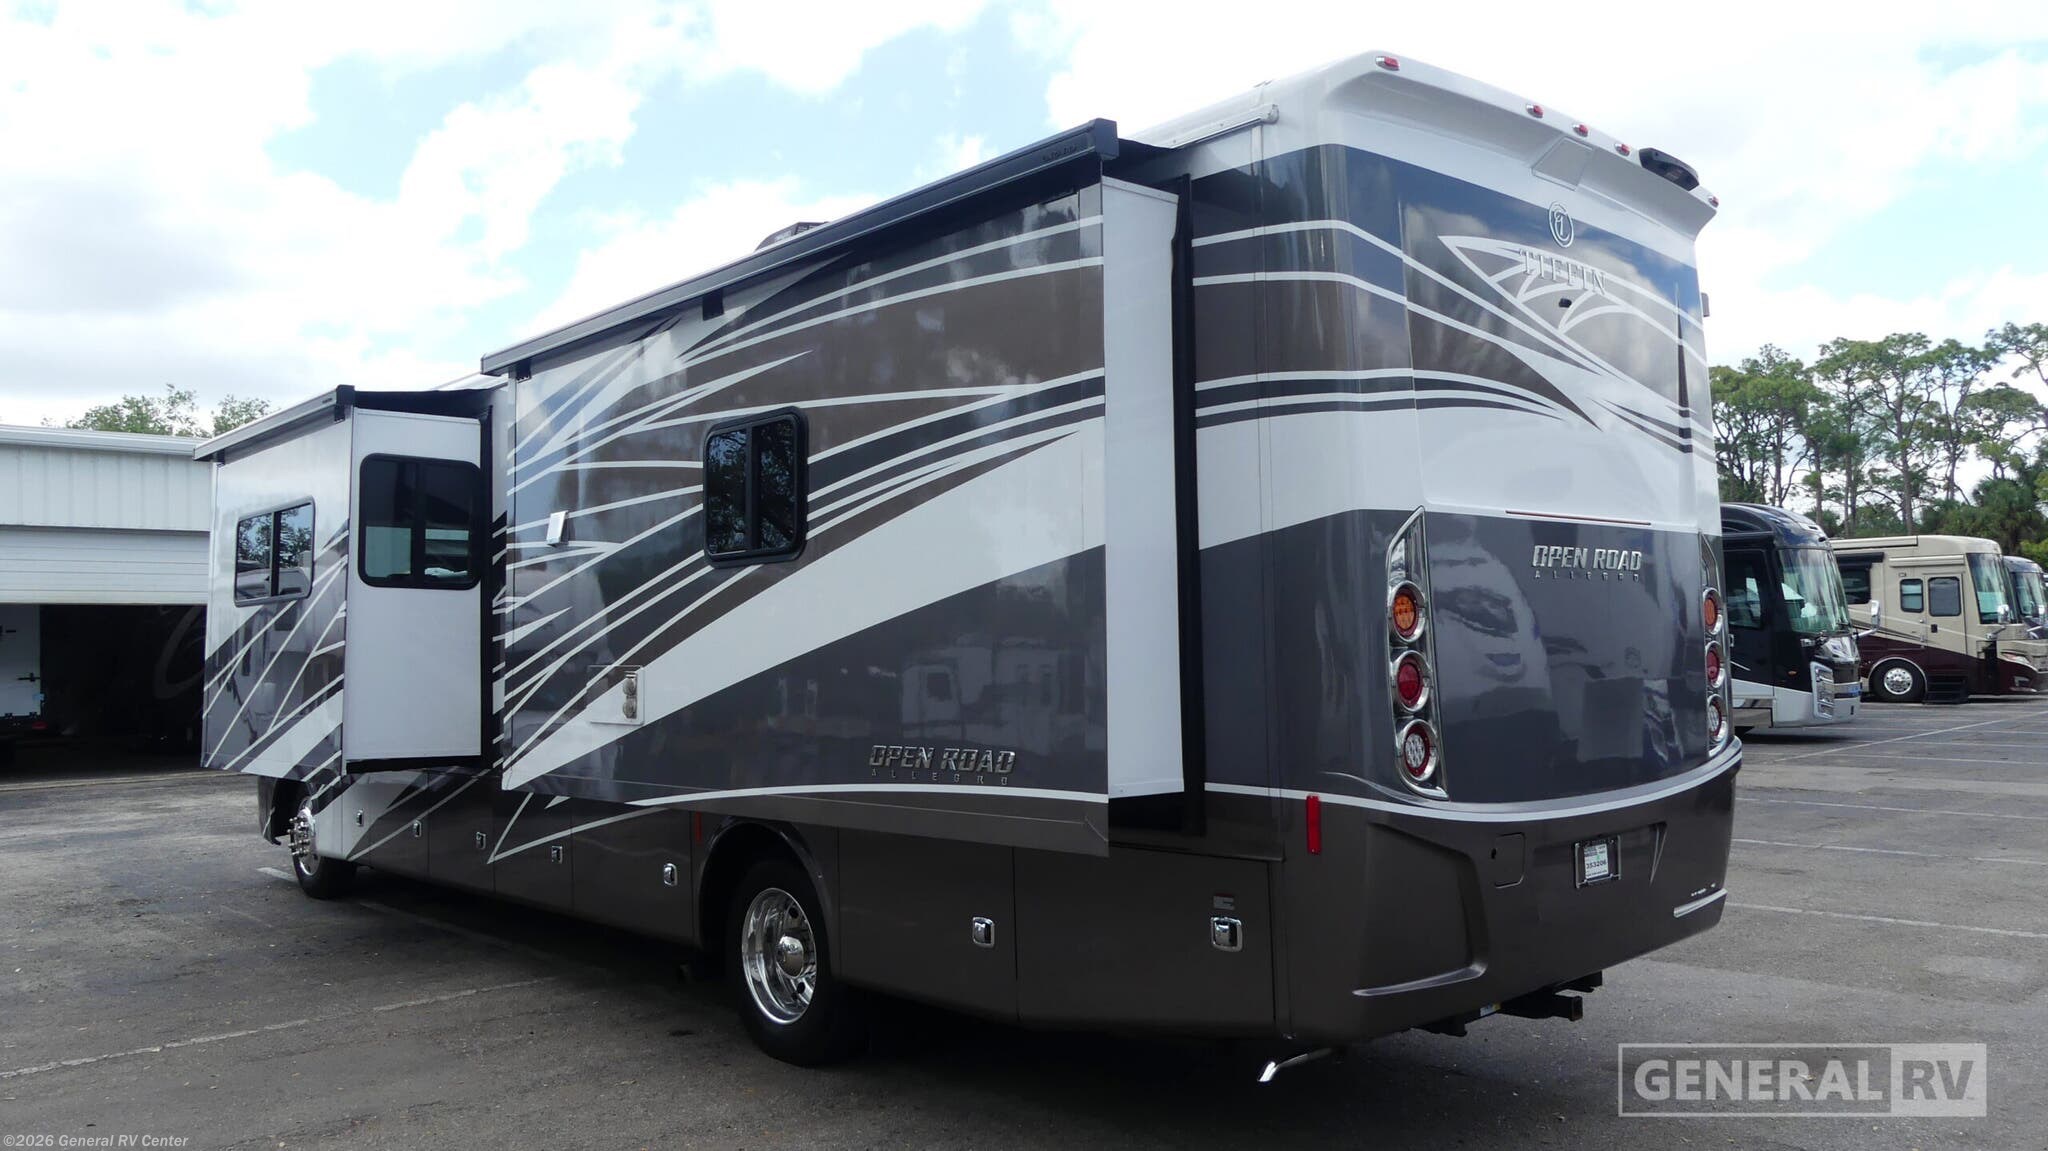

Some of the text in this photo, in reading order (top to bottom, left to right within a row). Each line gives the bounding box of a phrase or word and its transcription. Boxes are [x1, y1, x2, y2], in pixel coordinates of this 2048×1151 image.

[1519, 248, 1606, 295] TIFFIN
[1532, 545, 1642, 571] OPEN ROAD
[869, 745, 1015, 773] OPEN ROAD
[871, 768, 1008, 785] ALLEGRO
